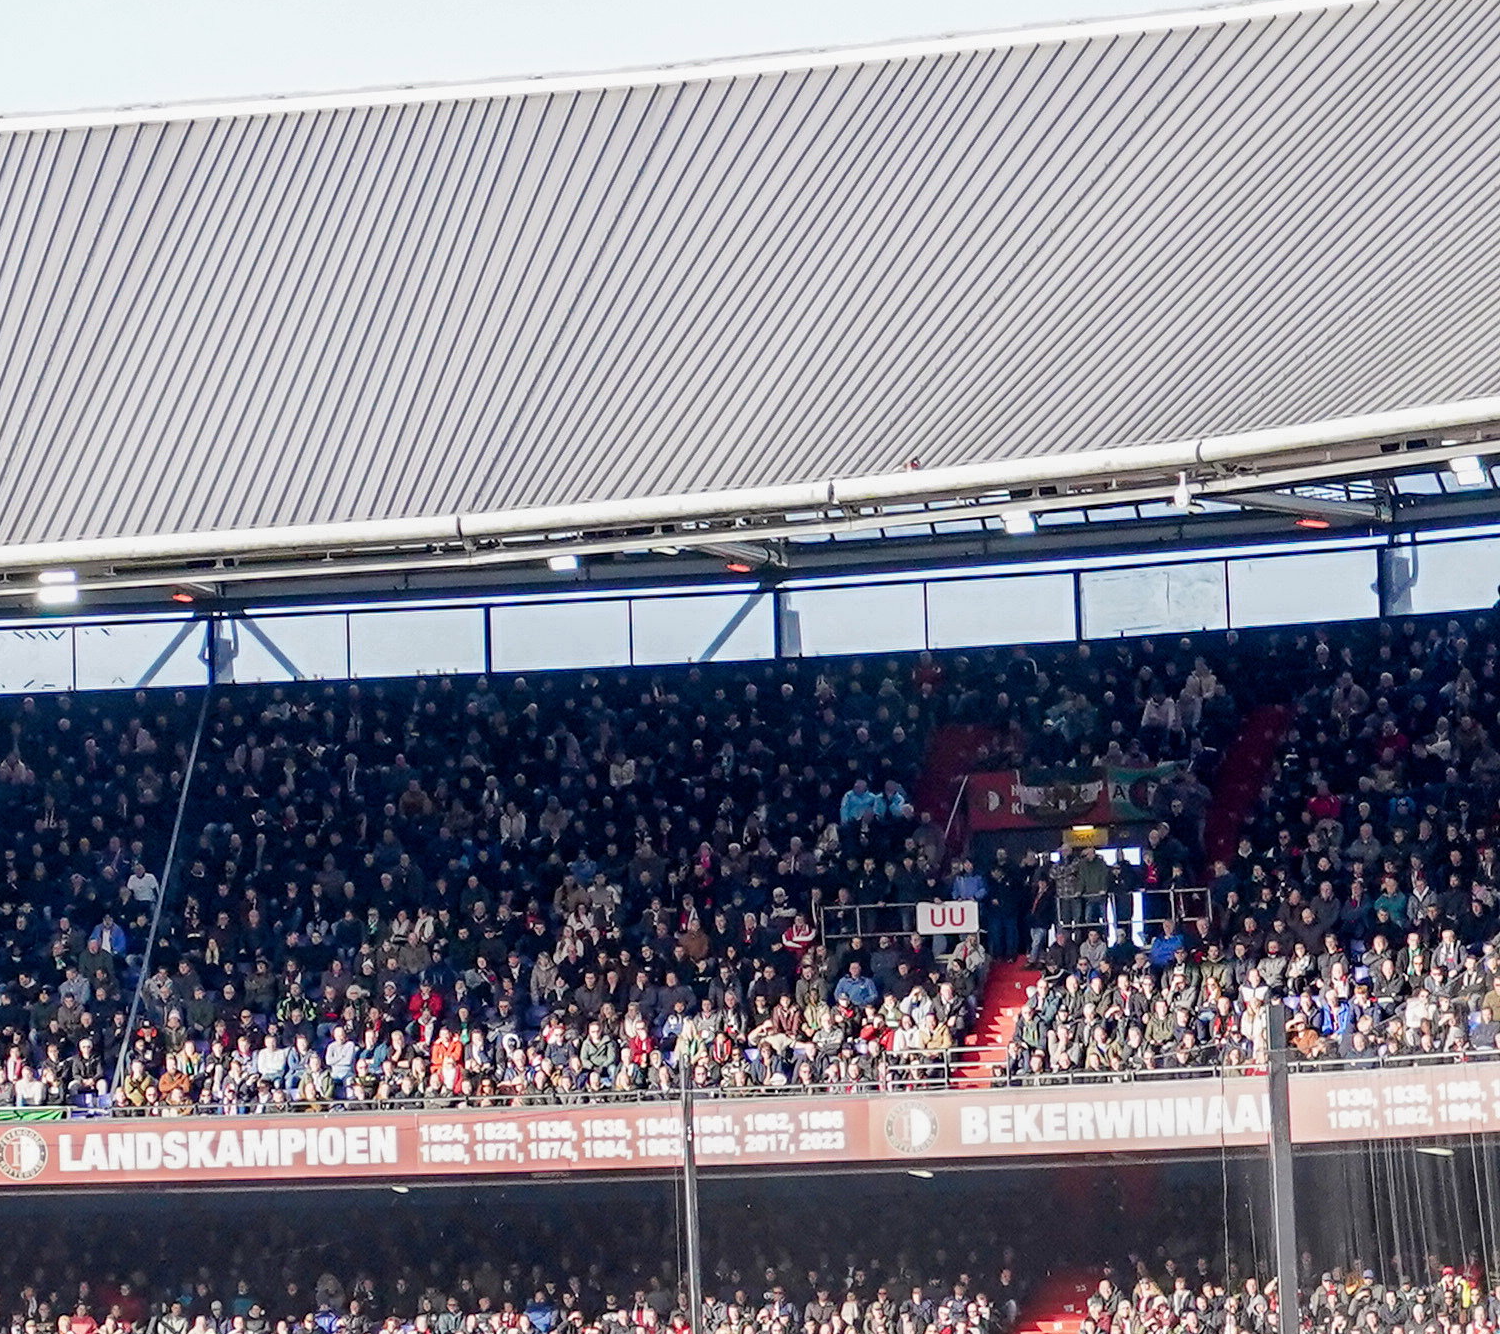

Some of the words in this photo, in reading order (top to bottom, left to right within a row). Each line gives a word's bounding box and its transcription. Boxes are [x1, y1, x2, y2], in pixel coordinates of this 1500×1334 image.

[929, 907, 966, 928] UU
[960, 1095, 1271, 1145] BEKERWINNAA
[58, 1125, 398, 1172] LANDSKAMPIOEN
